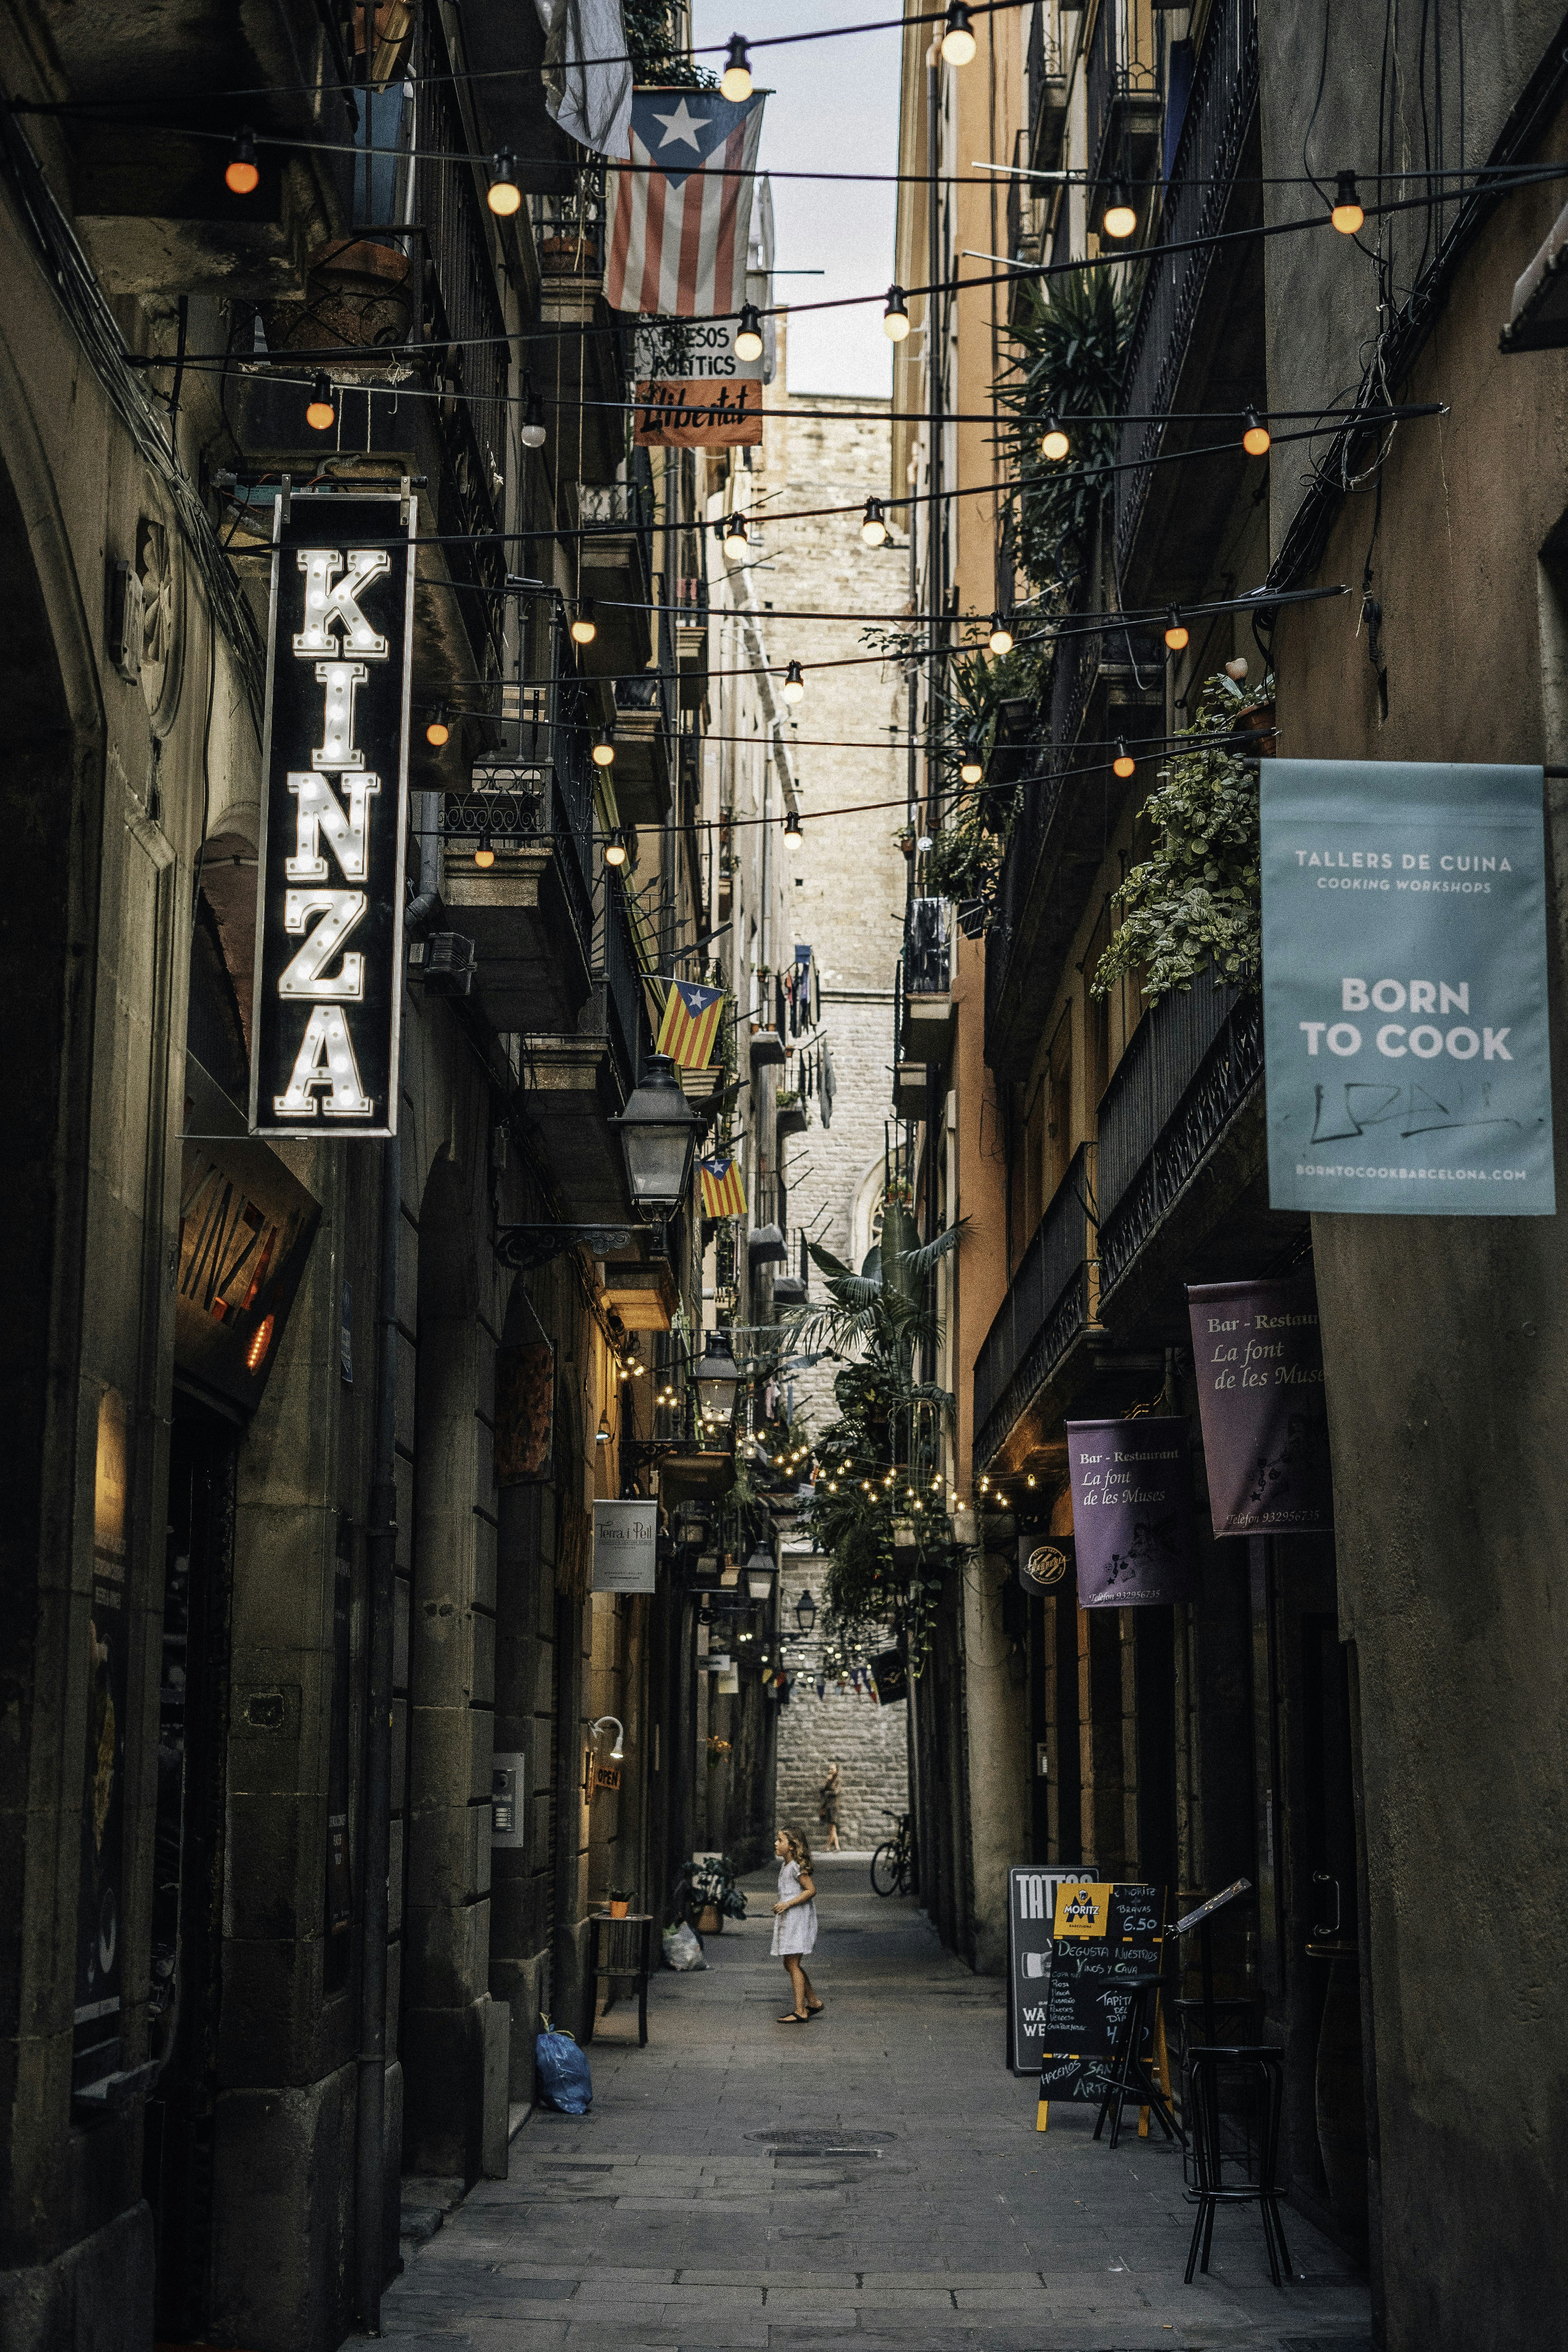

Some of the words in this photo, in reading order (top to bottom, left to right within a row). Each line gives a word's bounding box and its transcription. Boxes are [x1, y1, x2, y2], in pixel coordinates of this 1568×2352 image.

[274, 549, 391, 1117] KINZA
[1295, 850, 1393, 869] TALLERS
[1402, 853, 1431, 870] DE
[1440, 855, 1513, 872] CUINA
[1317, 877, 1391, 891] COOKING
[1396, 880, 1491, 894] WORKSHOPS
[1342, 977, 1469, 1014] BORN
[1299, 1021, 1363, 1056] TO
[1376, 1023, 1513, 1060] COOK
[1296, 1164, 1527, 1180] BORNTOCOOKBARCELONA.COM
[1207, 1318, 1240, 1333] Bar
[1211, 1345, 1241, 1363] La
[1241, 1339, 1285, 1367] font
[1215, 1369, 1236, 1390] de
[1242, 1367, 1268, 1388] les
[1275, 1363, 1324, 1384] Muse
[1080, 1454, 1102, 1464] Bar
[1114, 1449, 1180, 1462] Restaurant
[1081, 1472, 1101, 1486] La
[1101, 1469, 1131, 1491] font
[1084, 1490, 1098, 1505] de
[1102, 1488, 1119, 1504] les
[1122, 1487, 1166, 1504] Muses
[633, 1521, 652, 1539] Pell
[598, 1769, 618, 1786] OPEN
[1064, 1905, 1100, 1915] MORITZ
[1117, 1905, 1152, 1913] BRAVAS
[1123, 1916, 1158, 1931] 6.50
[1056, 1940, 1109, 1957] DEGUSTA
[1114, 1963, 1138, 1974] CAVA
[1040, 2059, 1082, 2085] HACEMOS
